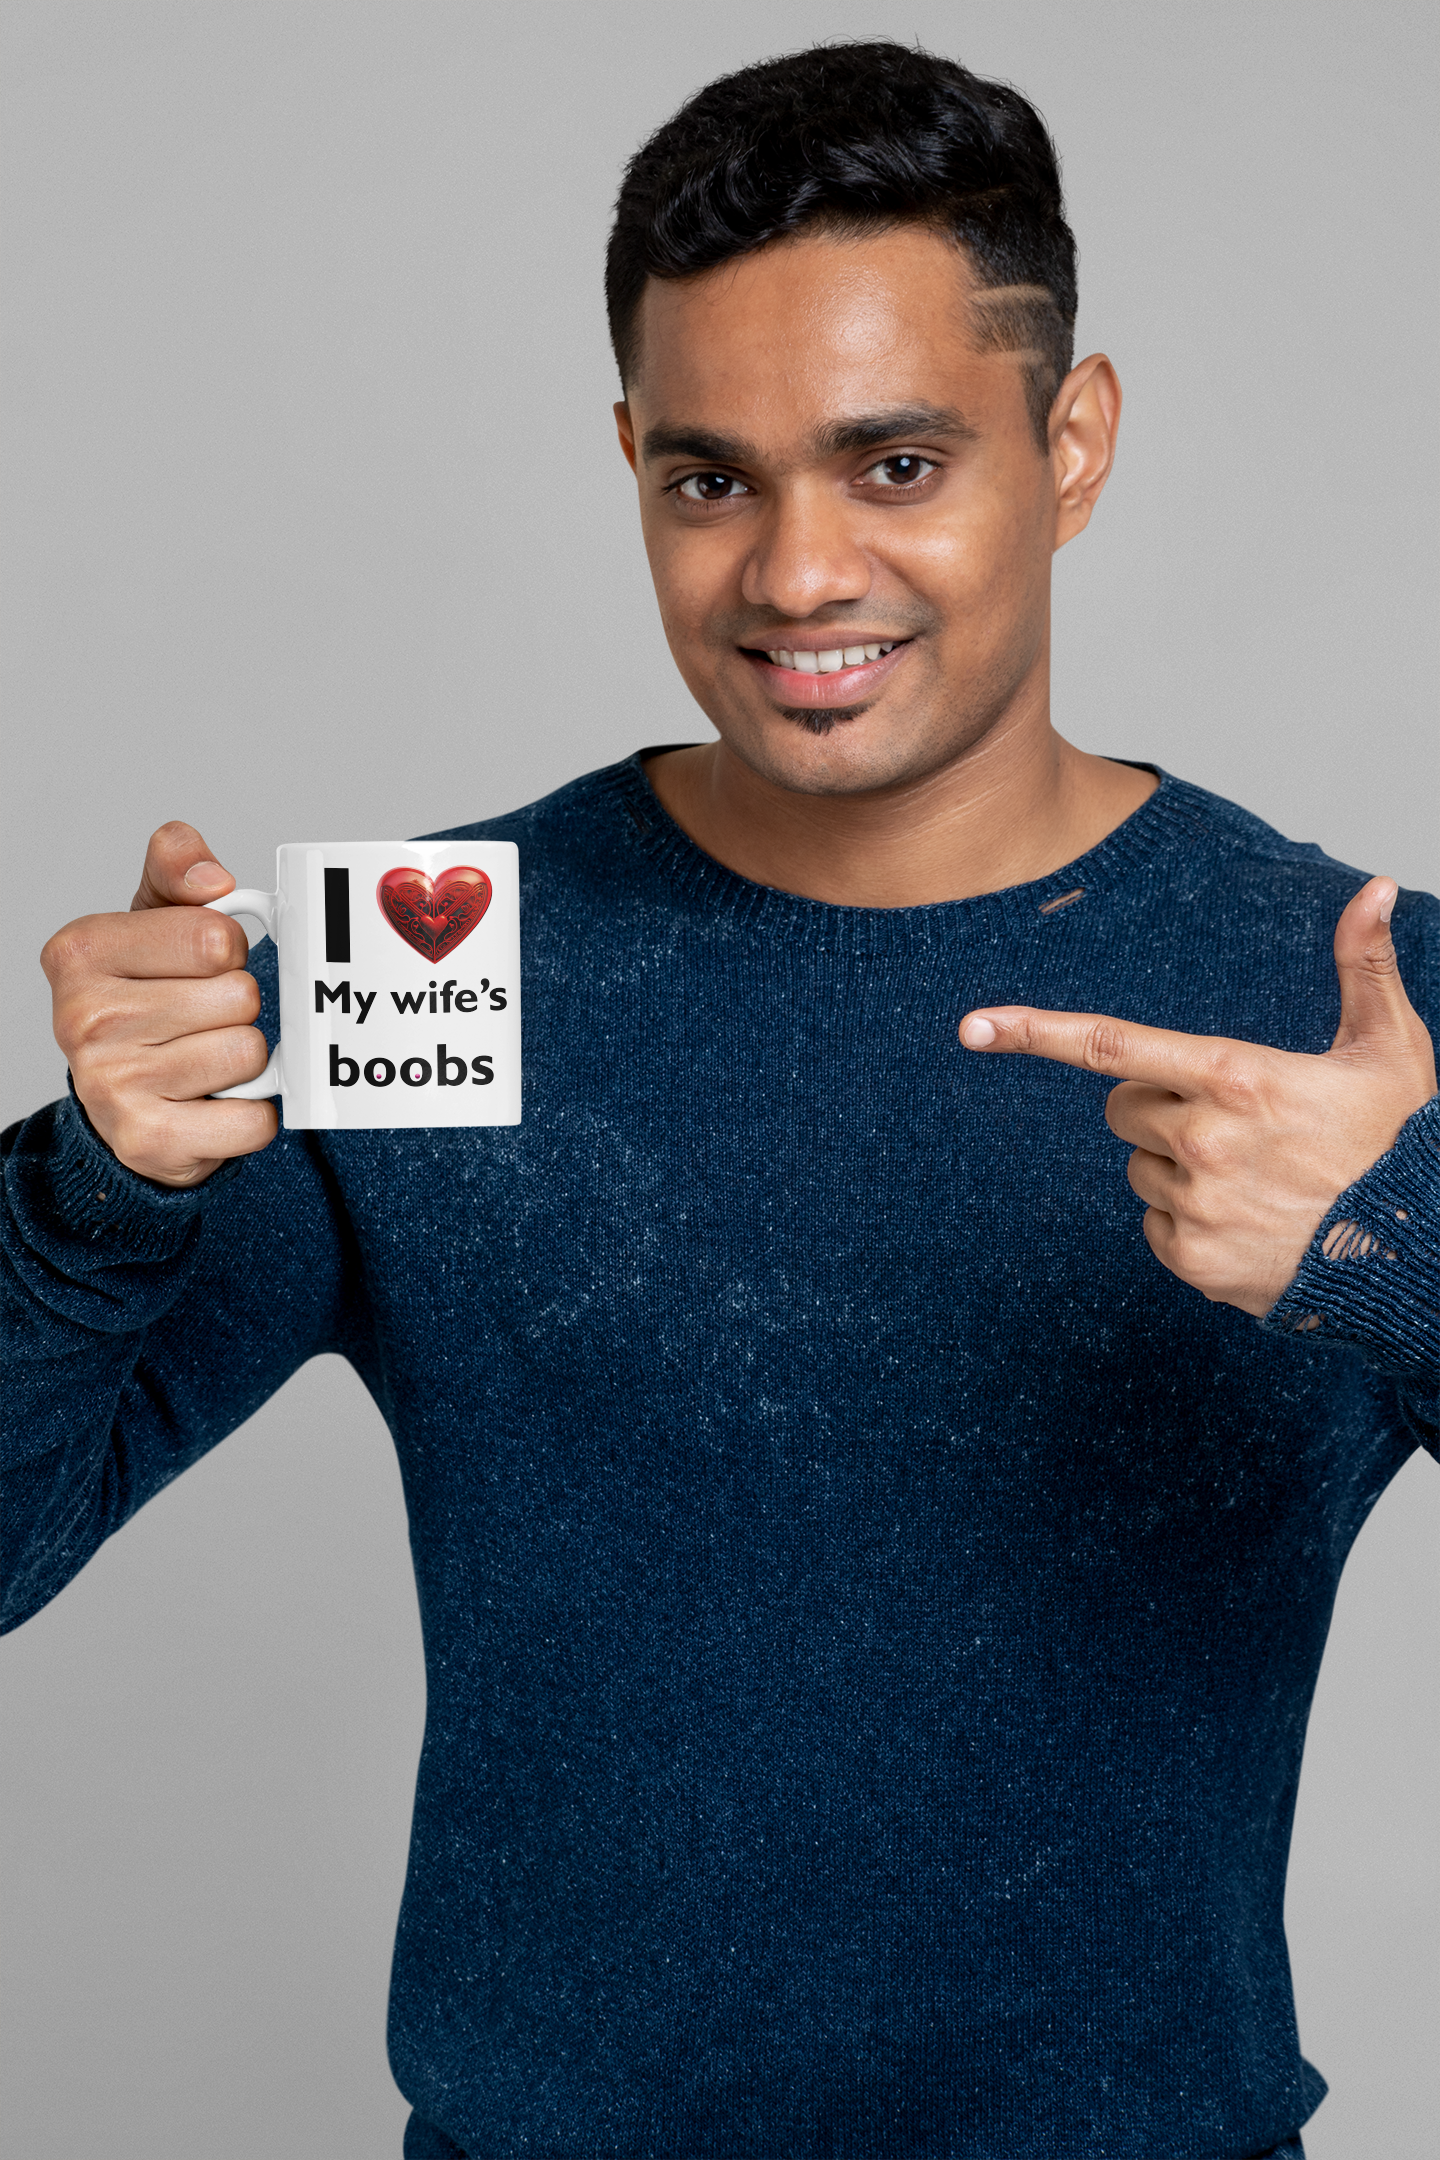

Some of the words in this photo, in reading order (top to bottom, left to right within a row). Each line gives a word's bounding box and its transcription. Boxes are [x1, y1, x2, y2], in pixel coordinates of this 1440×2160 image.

[324, 867, 351, 964] I
[314, 980, 378, 1025] My
[390, 978, 508, 1015] wife’s
[329, 1043, 495, 1088] boobs
